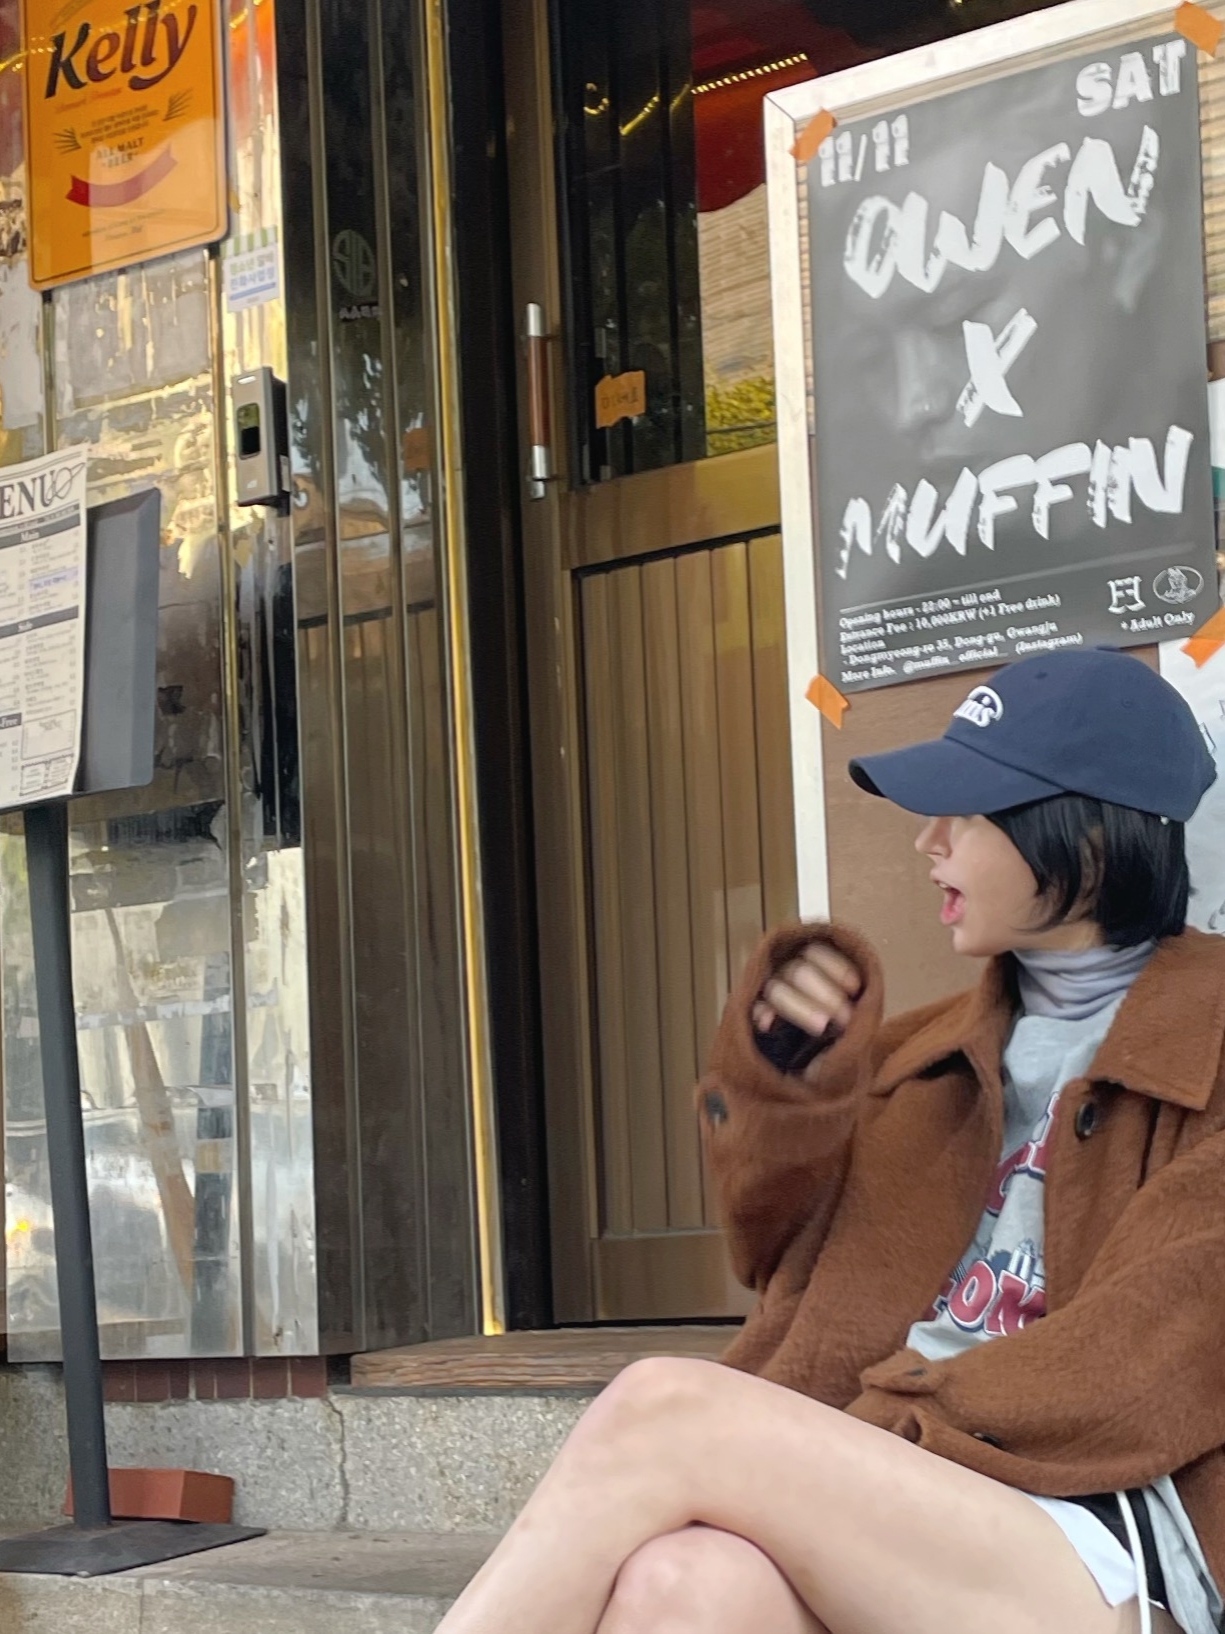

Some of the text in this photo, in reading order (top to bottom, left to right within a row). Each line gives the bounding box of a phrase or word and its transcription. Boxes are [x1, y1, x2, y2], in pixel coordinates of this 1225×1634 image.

[45, 0, 197, 99] Kelly
[818, 40, 1186, 187] 11/11 SAT
[843, 125, 1159, 298] OWEN
[956, 307, 1037, 428] X
[0, 470, 55, 519] ENU
[835, 425, 1194, 580] MUFFIN
[839, 612, 882, 630] Opening
[882, 606, 915, 620] hours
[961, 592, 979, 606] till
[979, 589, 1002, 603] end
[840, 626, 886, 643] Entrance
[886, 622, 908, 635] Fee
[997, 602, 1025, 615] Free
[1025, 594, 1061, 610] drink)
[1006, 621, 1058, 639] Gwangju
[1130, 611, 1195, 632] Adult Only
[841, 670, 870, 683] More
[1015, 632, 1084, 655] (Instagram)
